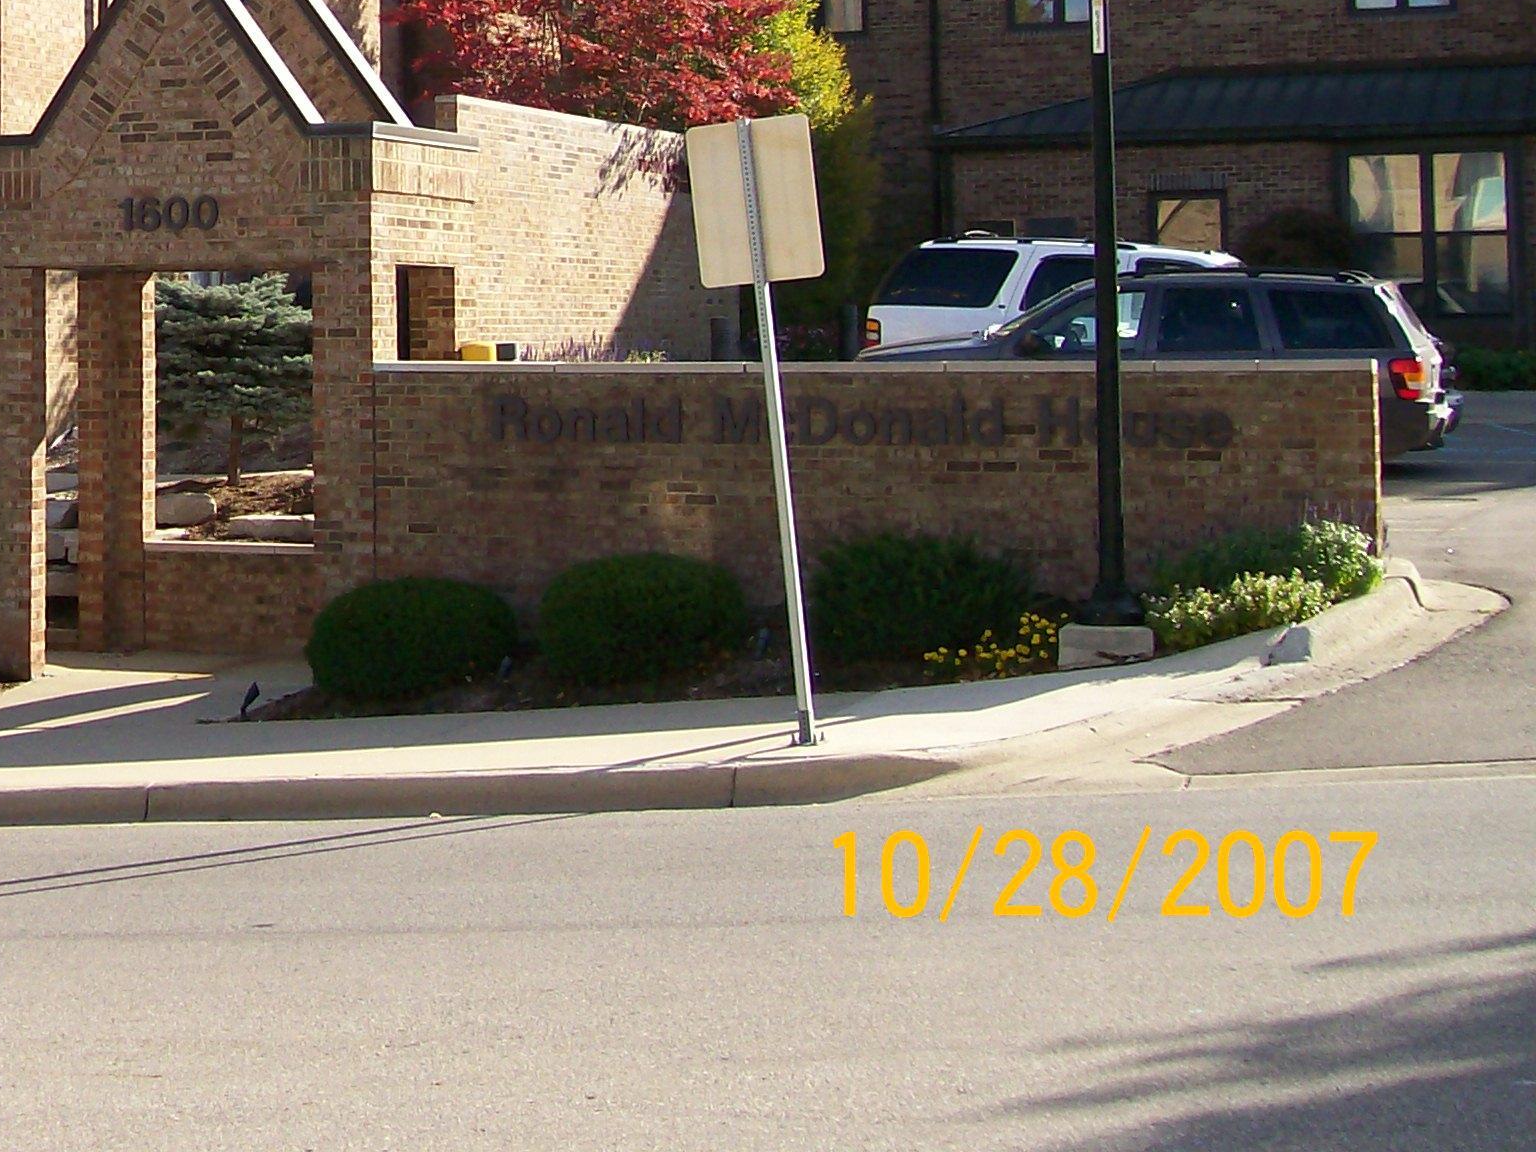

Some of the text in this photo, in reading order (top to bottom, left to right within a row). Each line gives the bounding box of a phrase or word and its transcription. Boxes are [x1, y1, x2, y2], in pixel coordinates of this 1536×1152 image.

[118, 196, 219, 232] 1600
[492, 395, 683, 445] Ronald
[713, 394, 1006, 447] MDonald
